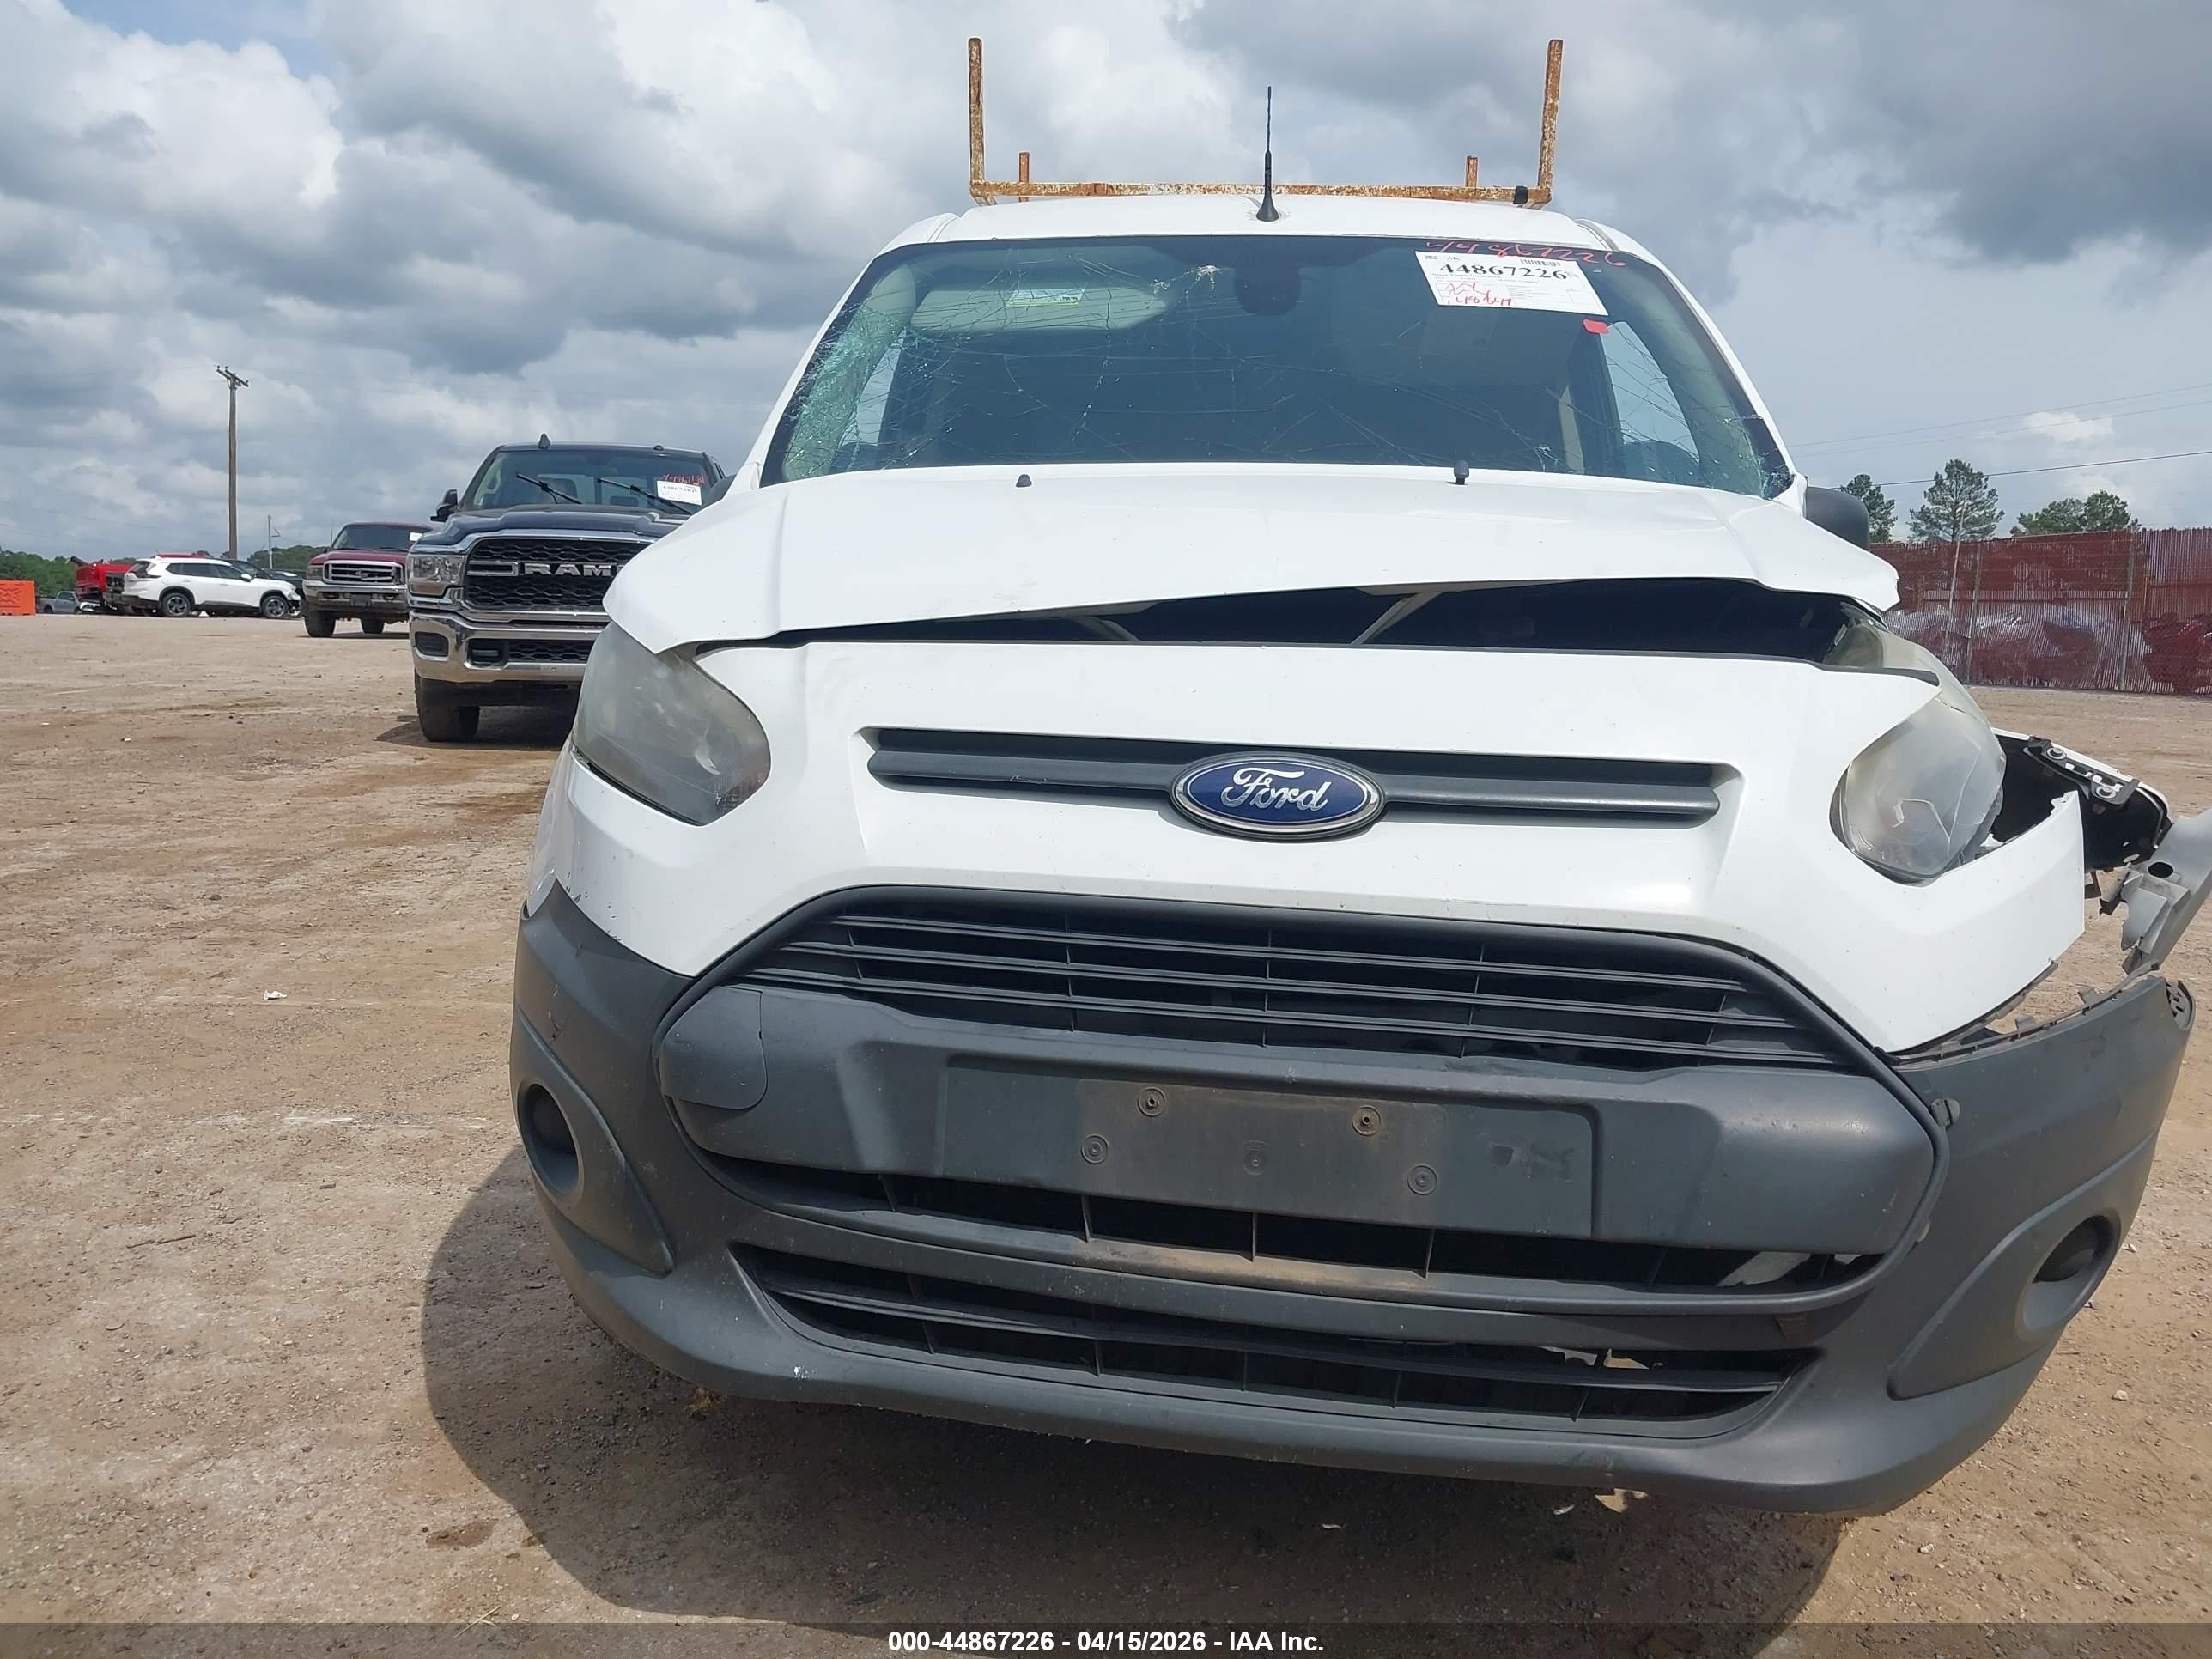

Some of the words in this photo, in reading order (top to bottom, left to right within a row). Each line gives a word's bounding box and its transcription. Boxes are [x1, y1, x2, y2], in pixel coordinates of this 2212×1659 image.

[1440, 264, 1567, 280] 44867226
[525, 562, 611, 576] RAM
[1221, 767, 1332, 811] Ford
